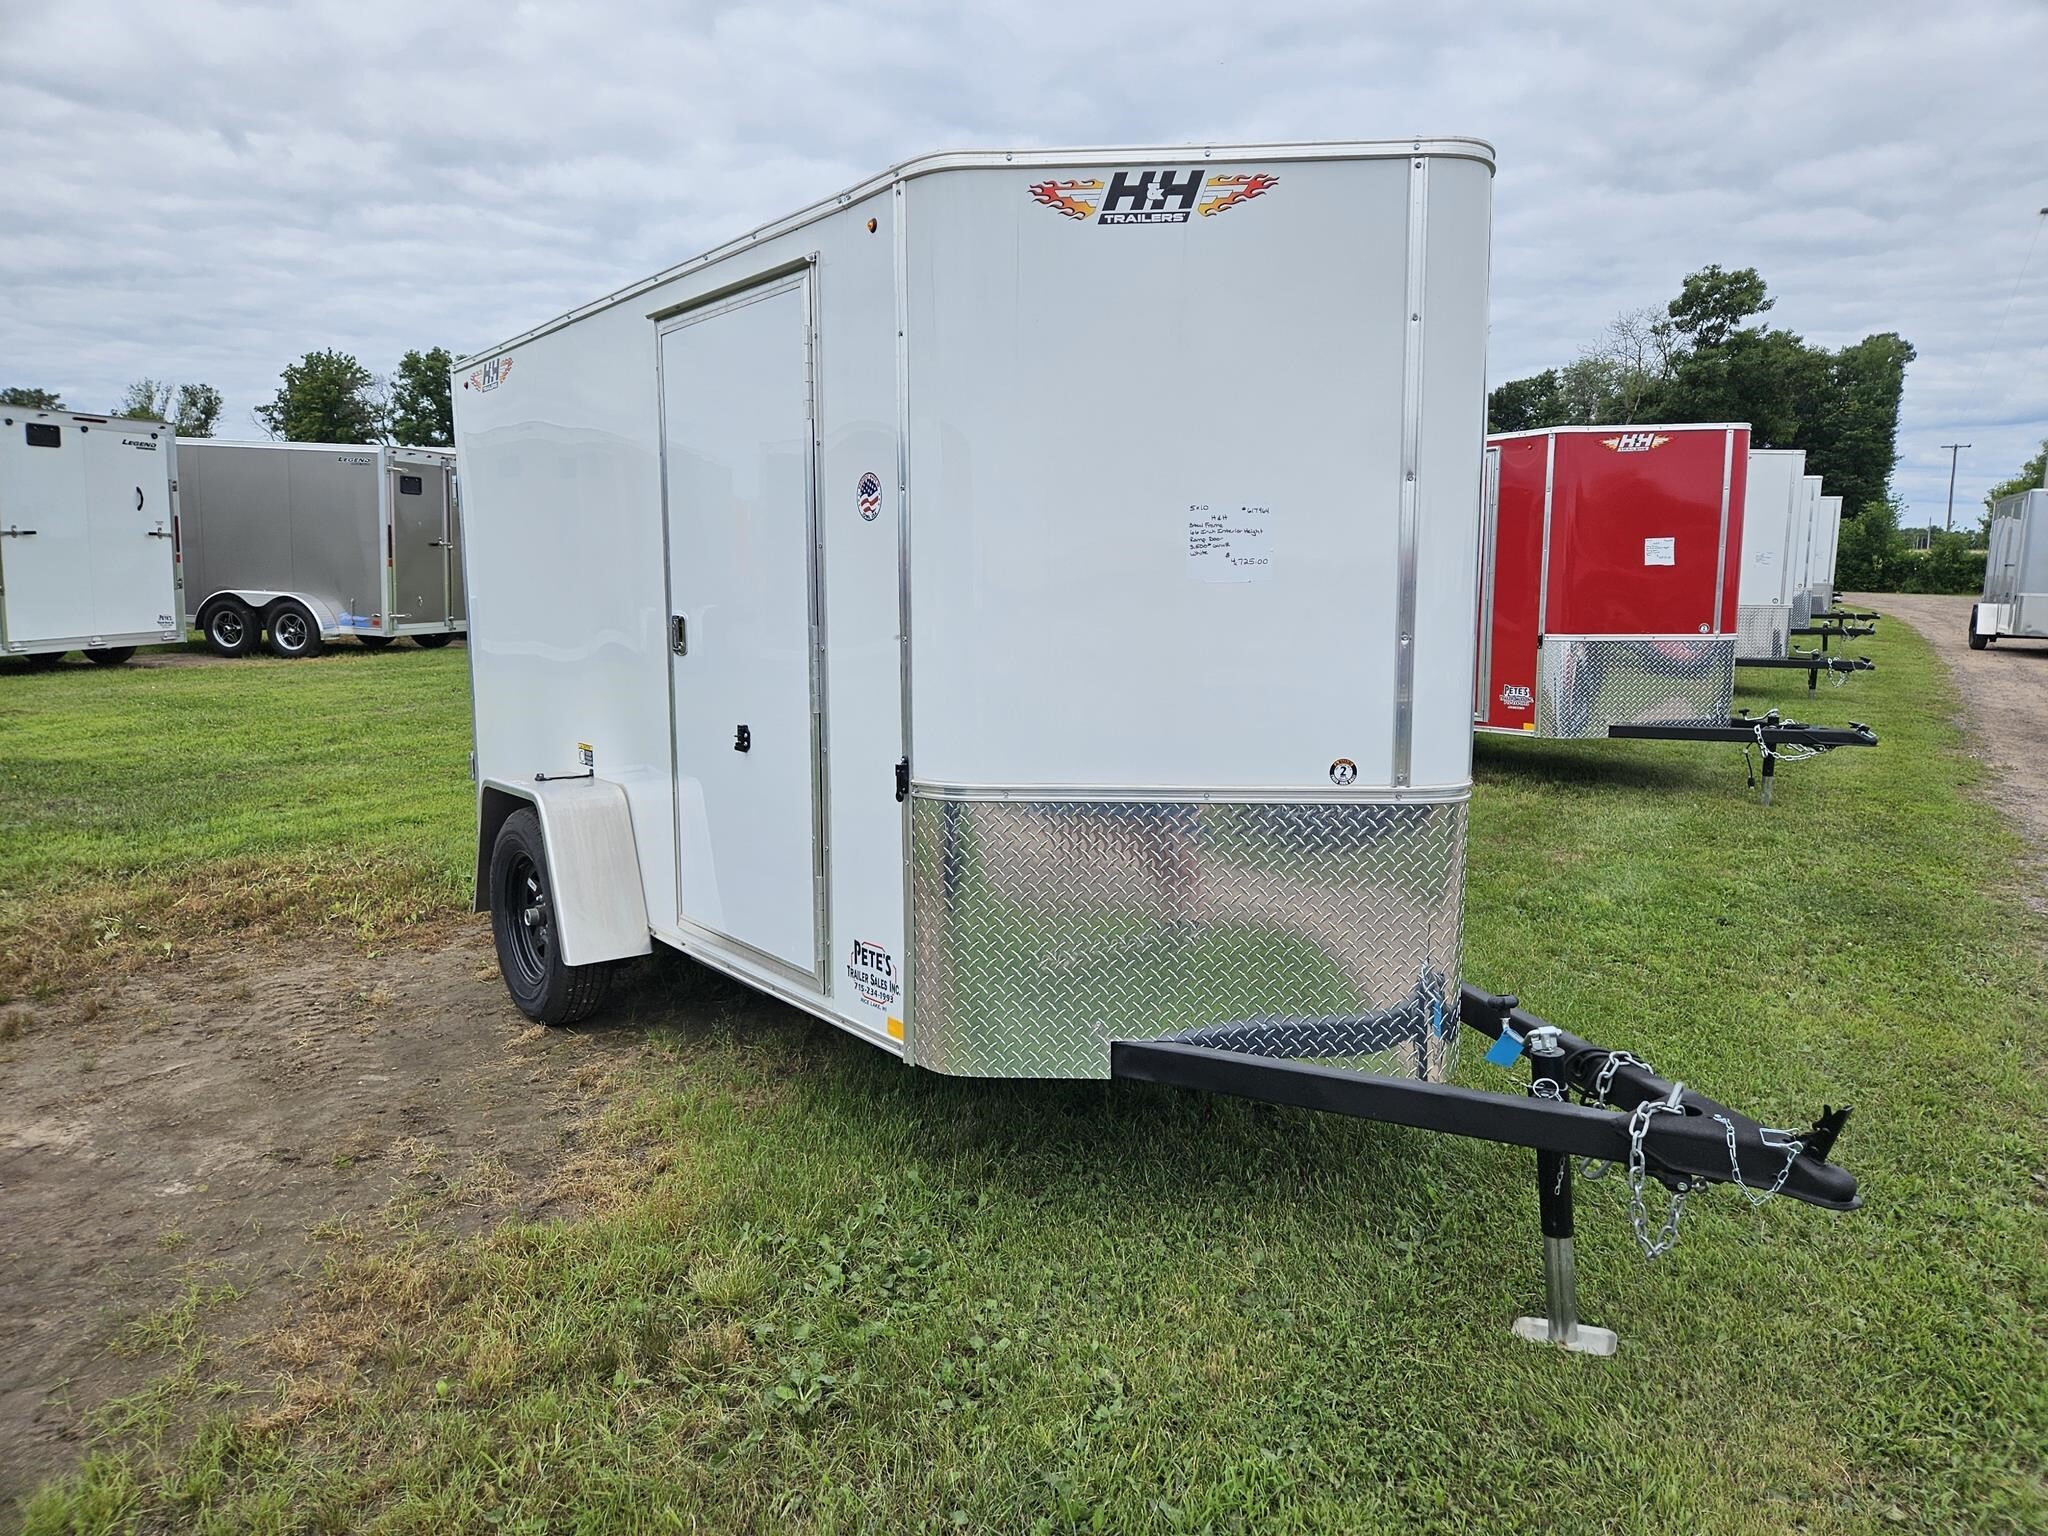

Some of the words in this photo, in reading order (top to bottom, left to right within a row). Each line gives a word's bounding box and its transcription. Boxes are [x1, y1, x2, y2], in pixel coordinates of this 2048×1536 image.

[1102, 170, 1205, 212] H&H
[1104, 213, 1186, 224] TRAILERS
[122, 439, 157, 448] LEGEND
[1339, 765, 1346, 776] 2
[854, 939, 892, 976] PETE'S
[847, 965, 869, 984] TRAILER
[870, 973, 888, 991] SALES
